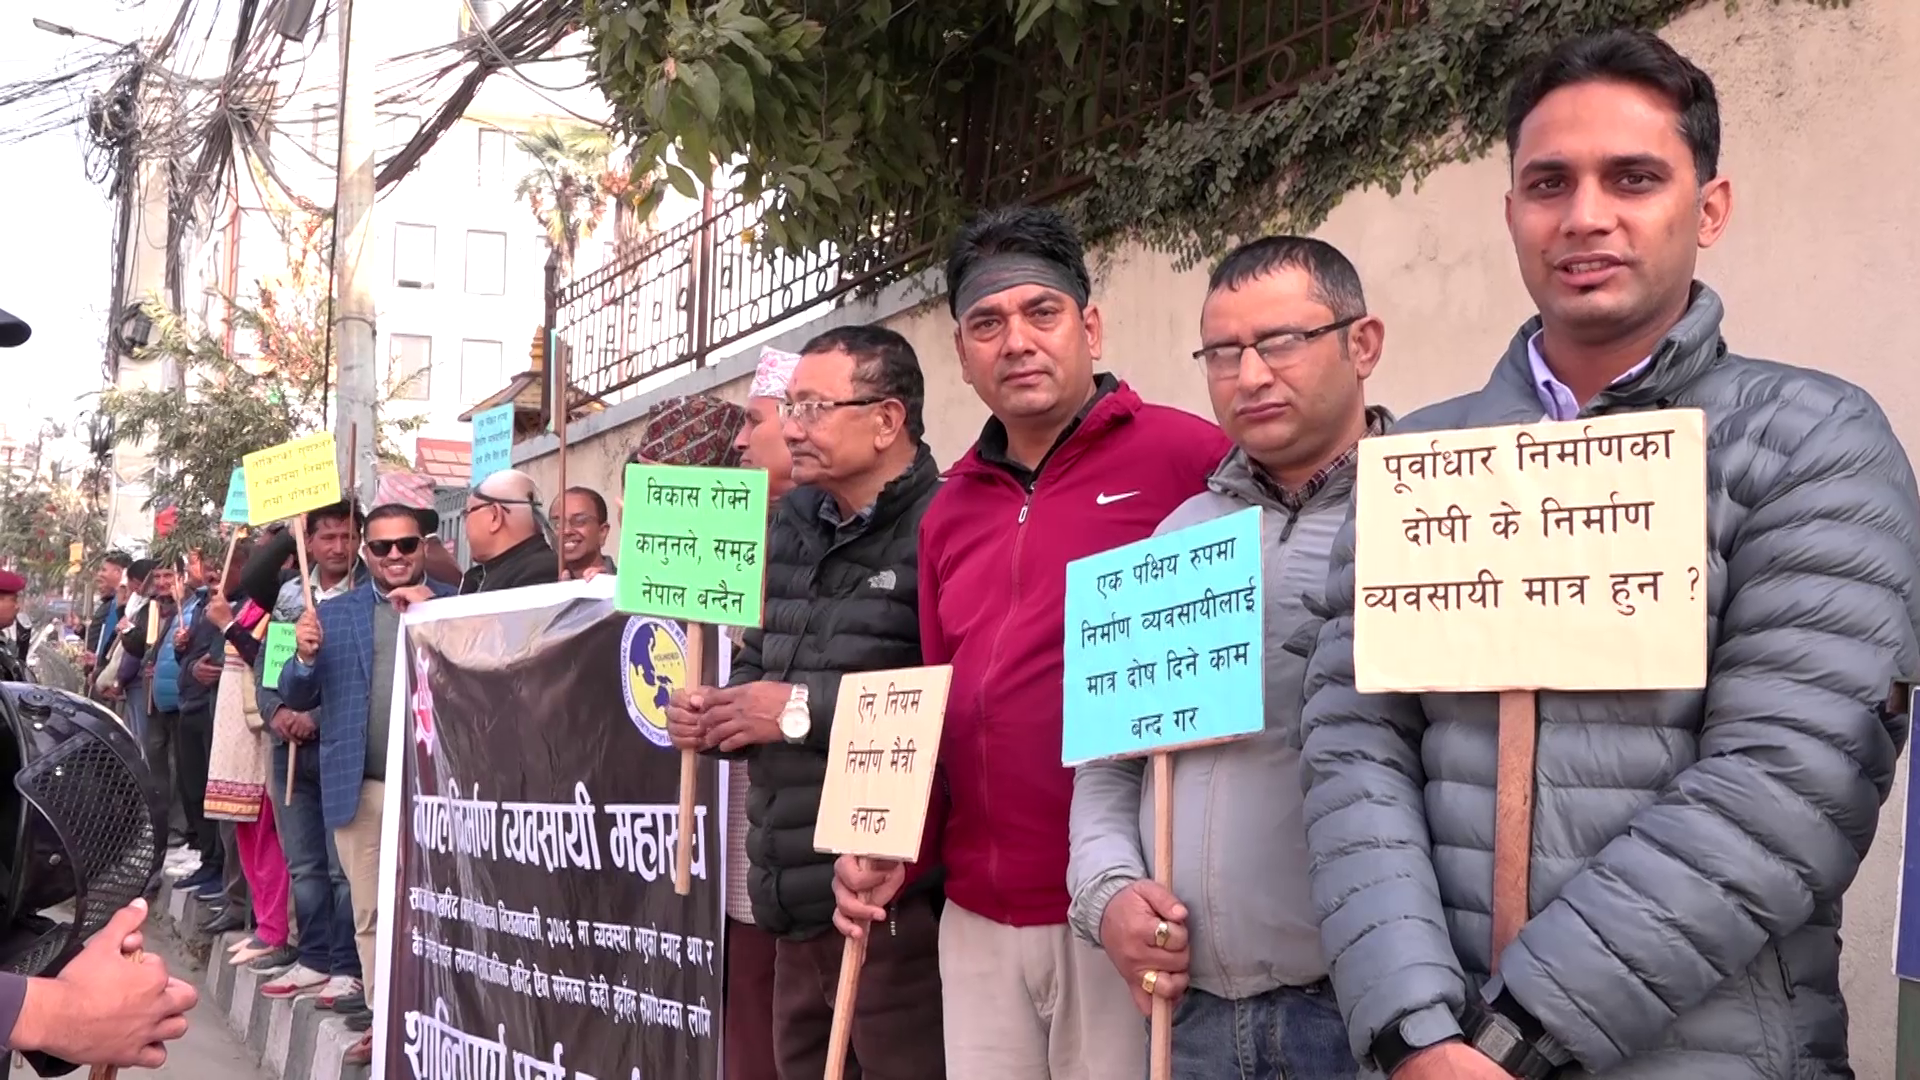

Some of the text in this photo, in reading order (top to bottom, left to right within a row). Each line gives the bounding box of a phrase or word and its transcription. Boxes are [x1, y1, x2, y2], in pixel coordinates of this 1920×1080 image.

[1383, 425, 1676, 494] पूर्वाधार निर्माणका
[647, 476, 751, 511] विकास रोक्ने
[1402, 491, 1655, 546] दोषी के निर्माण
[635, 529, 702, 565] कानुनले,
[641, 575, 687, 607] नेपाल
[1096, 569, 1123, 599] एक
[1132, 553, 1179, 585] पक्षिय
[1362, 567, 1700, 616] व्यवसायी मात्र हुन ?
[1081, 576, 1256, 648] निर्माण व्यवसायीलाई
[1086, 641, 1250, 697] मात्र दोष दिने काम
[884, 681, 923, 716] नियम
[1131, 707, 1199, 739] बन्द गर
[844, 736, 917, 774] निर्माण मैत्री
[501, 781, 601, 873] व्यवसायी
[576, 919, 590, 947] मा
[593, 922, 631, 954] व्यवस्था
[705, 939, 714, 976] र
[686, 995, 712, 1038] लागि
